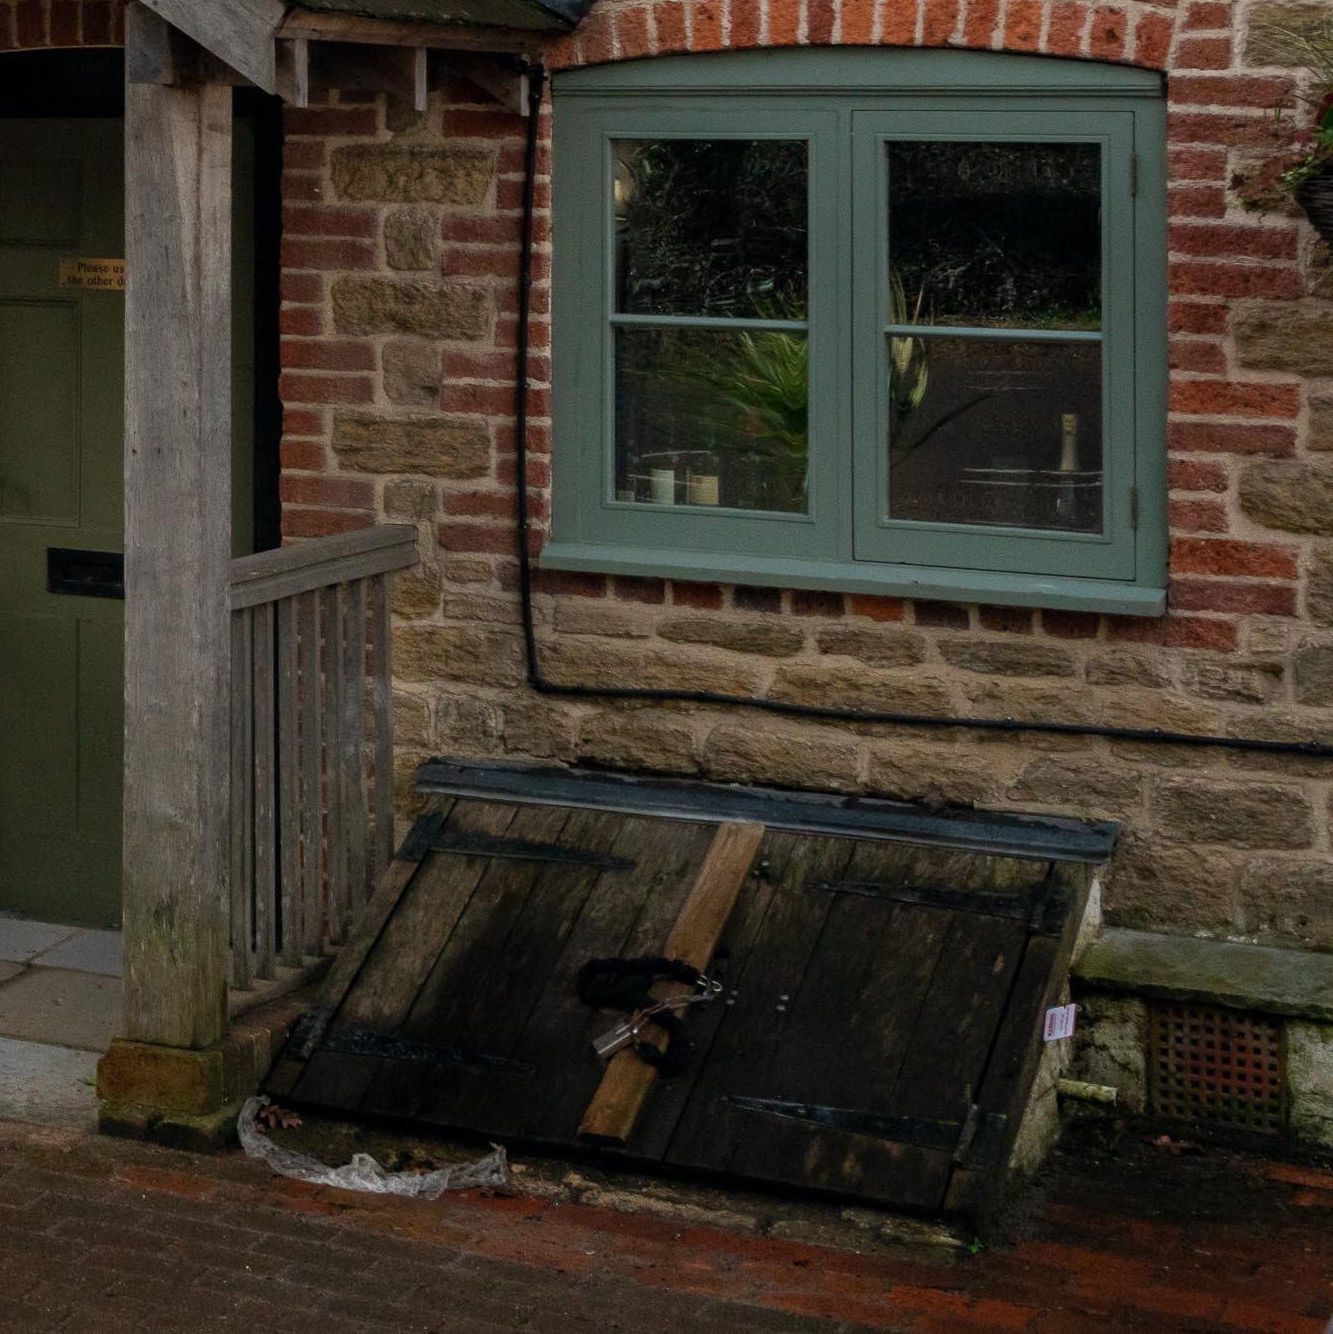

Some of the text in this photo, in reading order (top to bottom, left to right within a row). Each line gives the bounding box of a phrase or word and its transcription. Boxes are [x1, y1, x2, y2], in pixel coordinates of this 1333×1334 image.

[77, 262, 126, 274] Please us
[68, 274, 84, 284] the
[86, 274, 113, 286] other
